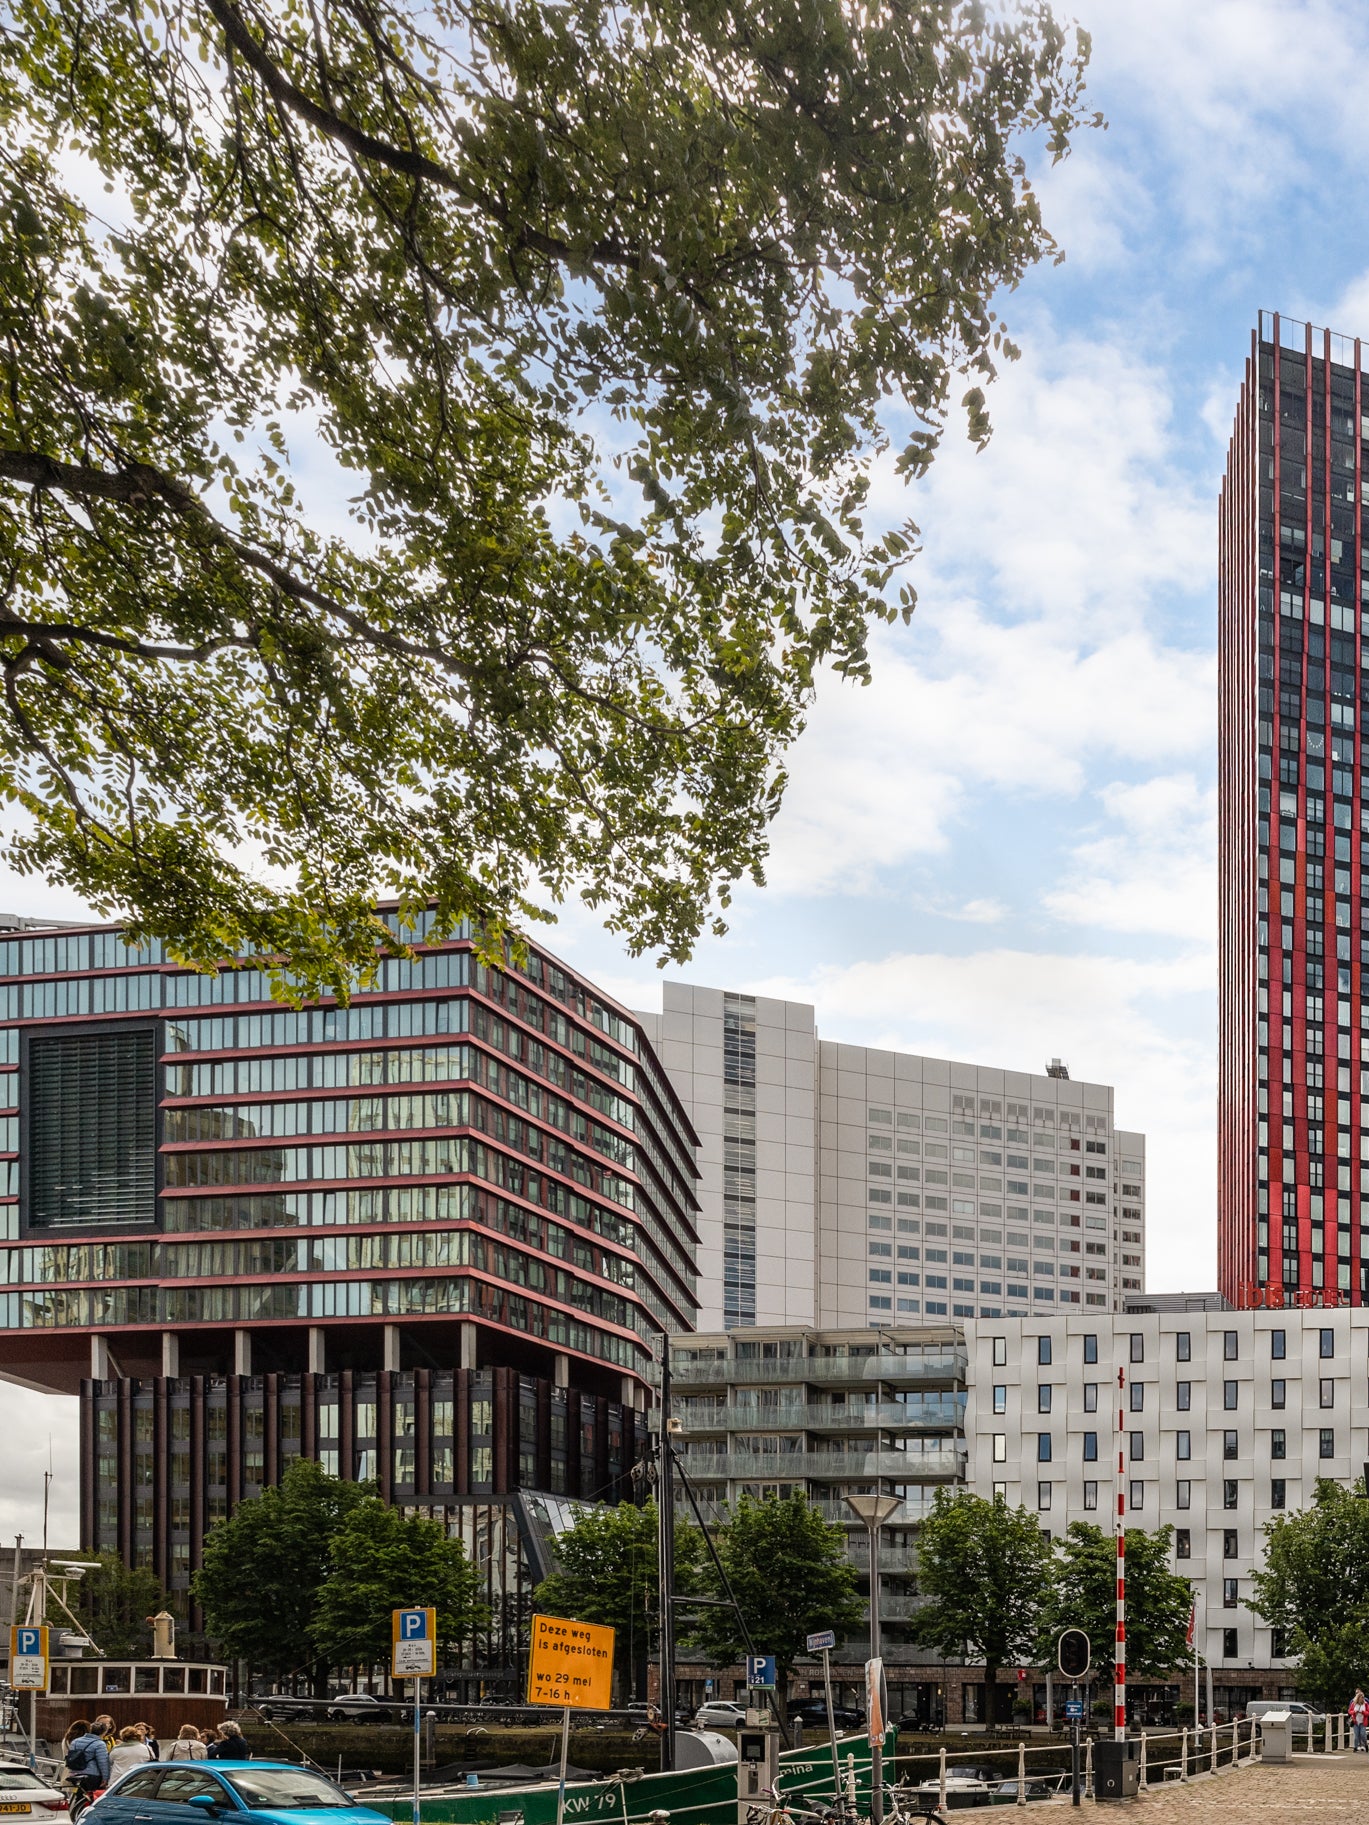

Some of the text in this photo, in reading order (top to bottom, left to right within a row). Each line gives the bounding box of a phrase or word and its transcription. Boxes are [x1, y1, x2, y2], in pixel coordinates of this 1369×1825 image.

[1238, 1281, 1349, 1307] ibis HOTEL
[406, 1615, 421, 1638] P
[540, 1622, 591, 1642] Deze weg
[22, 1631, 36, 1653] P
[552, 1642, 608, 1658] afgesloten
[753, 1657, 767, 1674] P
[536, 1672, 592, 1687] wo 29 mei
[535, 1686, 570, 1700] 7-16 h
[563, 1793, 616, 1814] KW 79
